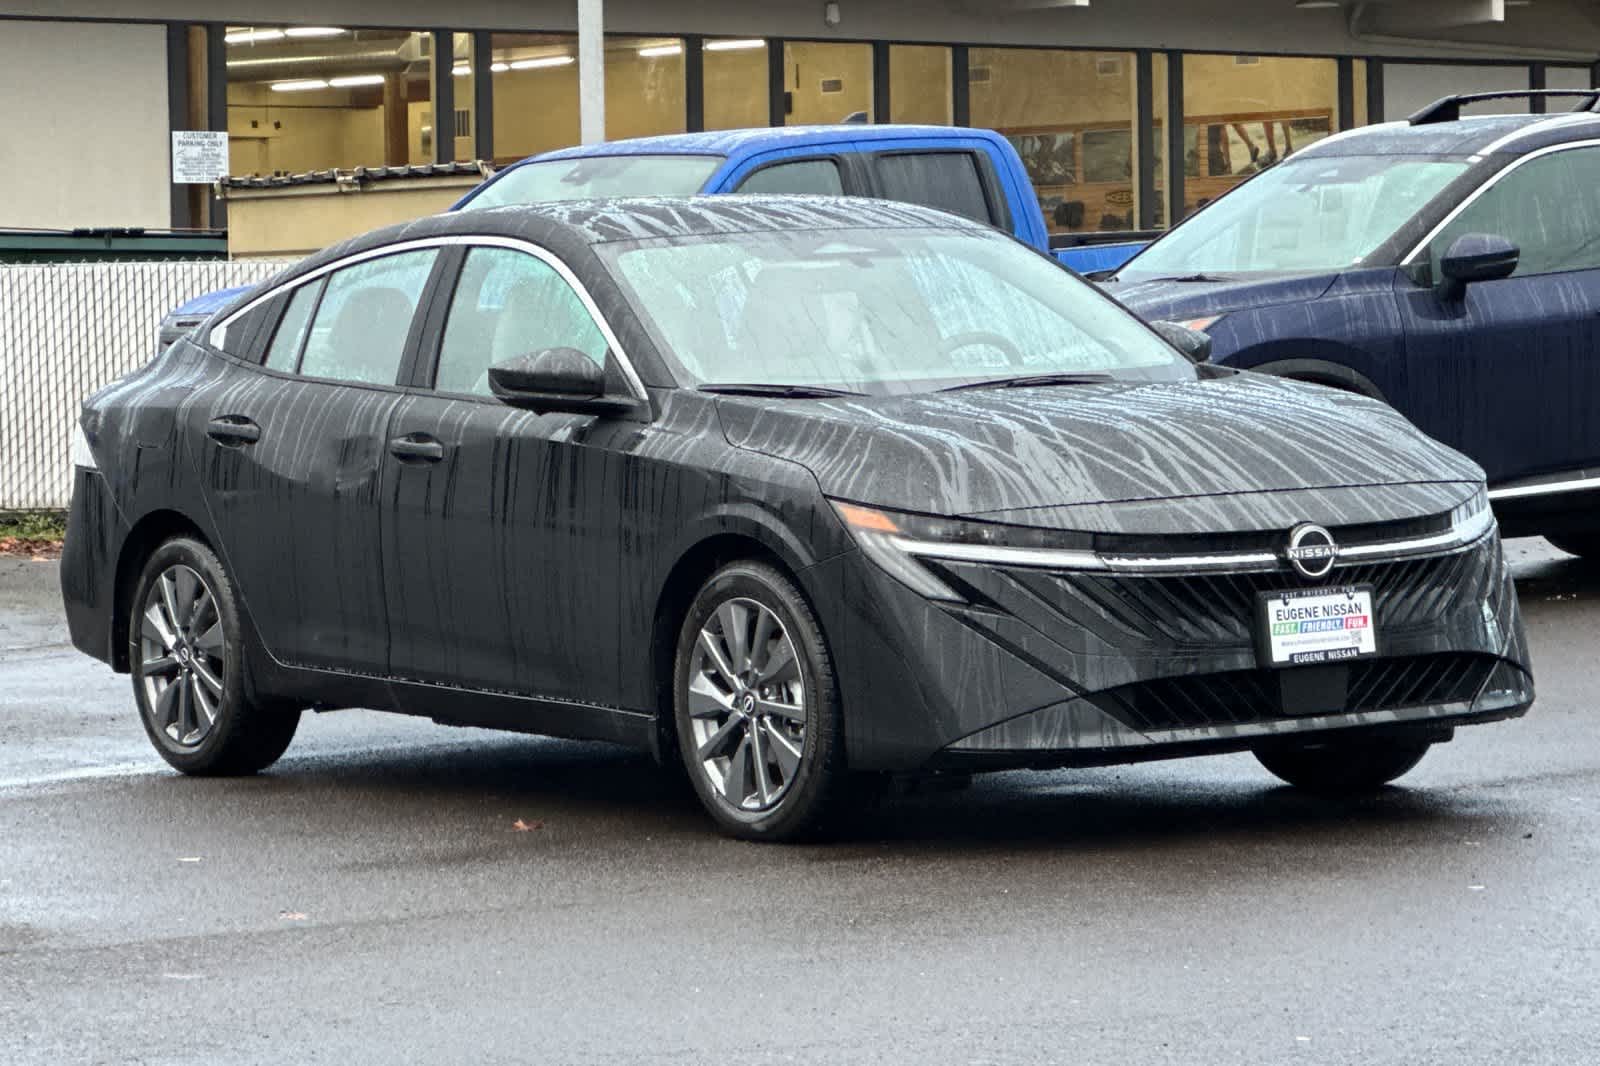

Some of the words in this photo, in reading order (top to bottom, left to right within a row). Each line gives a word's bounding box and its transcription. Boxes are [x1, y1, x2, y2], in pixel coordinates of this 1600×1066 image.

[1289, 546, 1338, 559] NISSAN
[1276, 606, 1319, 621] EUGENE
[1322, 602, 1362, 617] NISSAN
[1293, 651, 1325, 663] EUGENE
[1328, 647, 1357, 660] NISSAN
